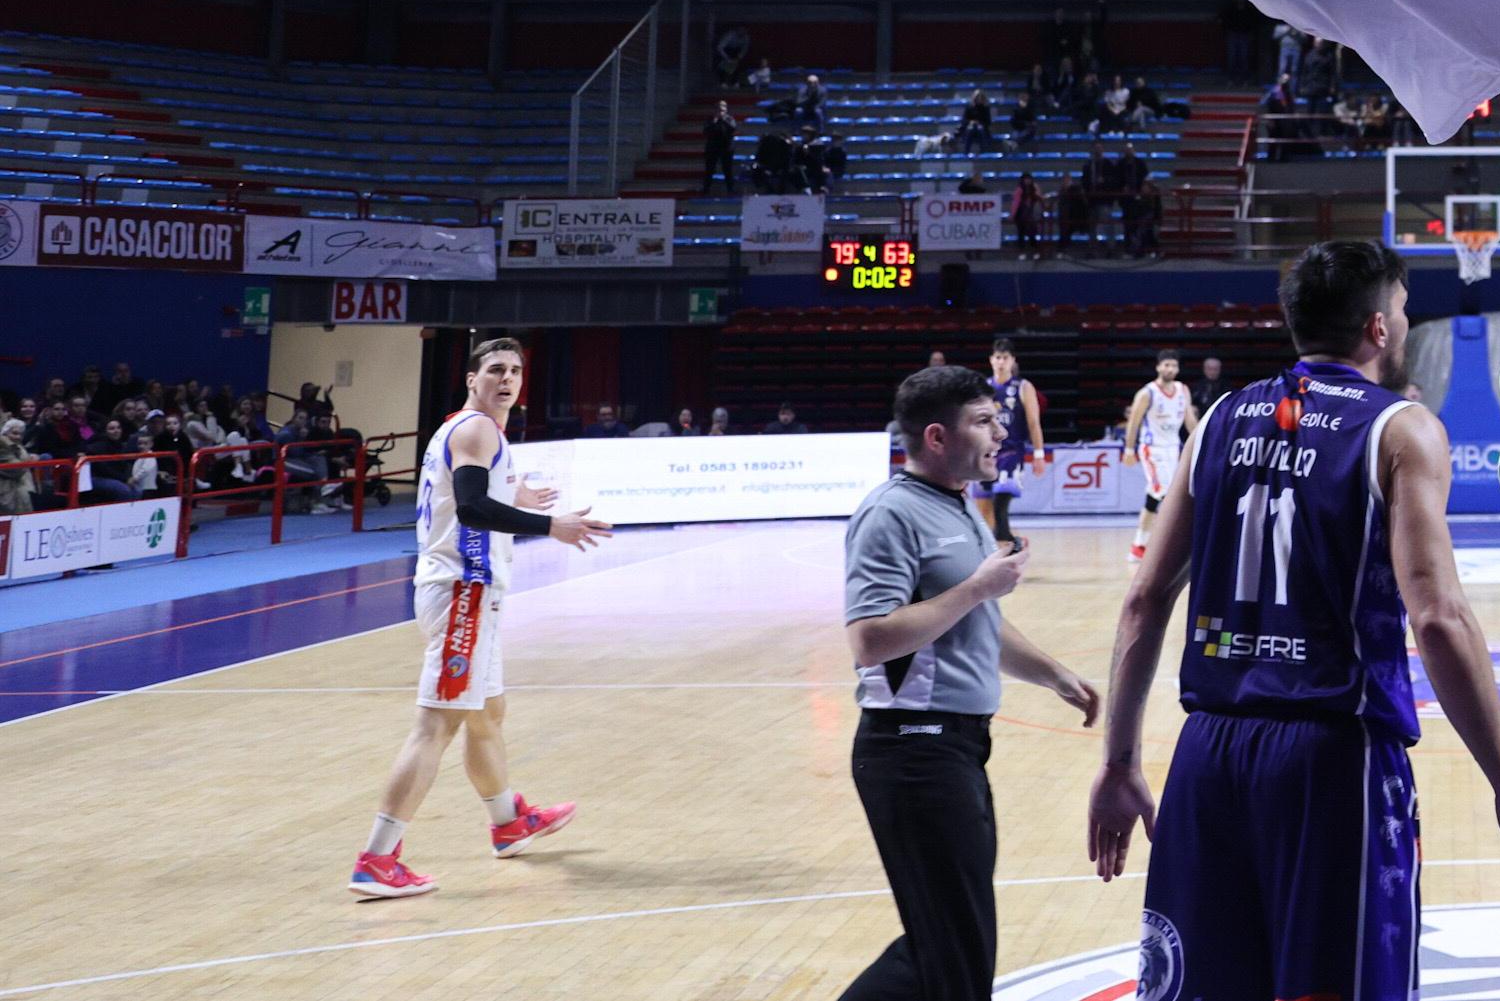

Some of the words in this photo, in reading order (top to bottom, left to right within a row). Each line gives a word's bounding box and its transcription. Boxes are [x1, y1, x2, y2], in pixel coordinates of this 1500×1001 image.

[948, 201, 995, 212] RMP
[84, 216, 232, 261] CASACOLOR
[543, 234, 633, 244] HOSPITALITY
[830, 242, 855, 265] 79
[863, 245, 877, 263] 4
[883, 242, 910, 265] 63
[852, 266, 898, 289] 0:02
[335, 282, 402, 321] BAR
[1300, 412, 1341, 432] EDILE
[700, 462, 737, 473] 0583
[743, 460, 804, 472] 1890231
[1235, 483, 1297, 606] 11
